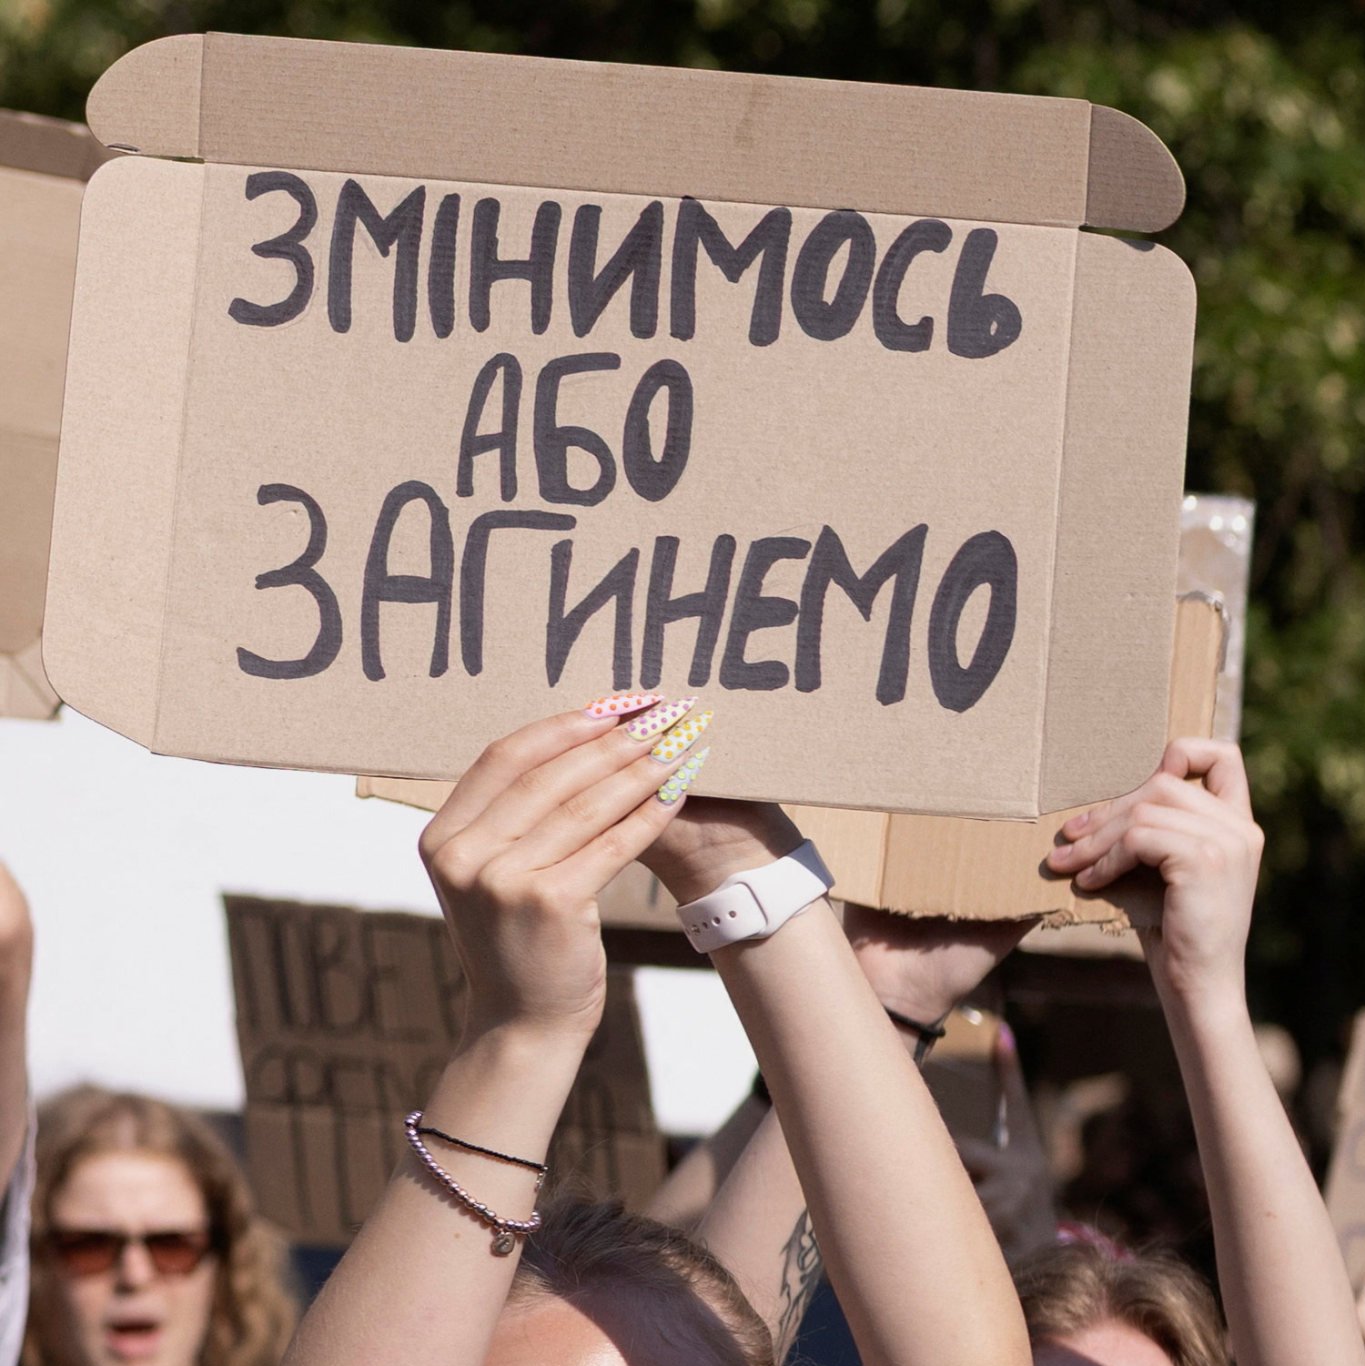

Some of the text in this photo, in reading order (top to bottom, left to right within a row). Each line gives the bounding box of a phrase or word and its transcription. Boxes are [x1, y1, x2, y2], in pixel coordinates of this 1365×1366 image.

[226, 168, 1023, 360] ЗМІНИМОСЬ
[456, 350, 696, 507] АБО
[236, 479, 1019, 714] ЗАГИНЕМО
